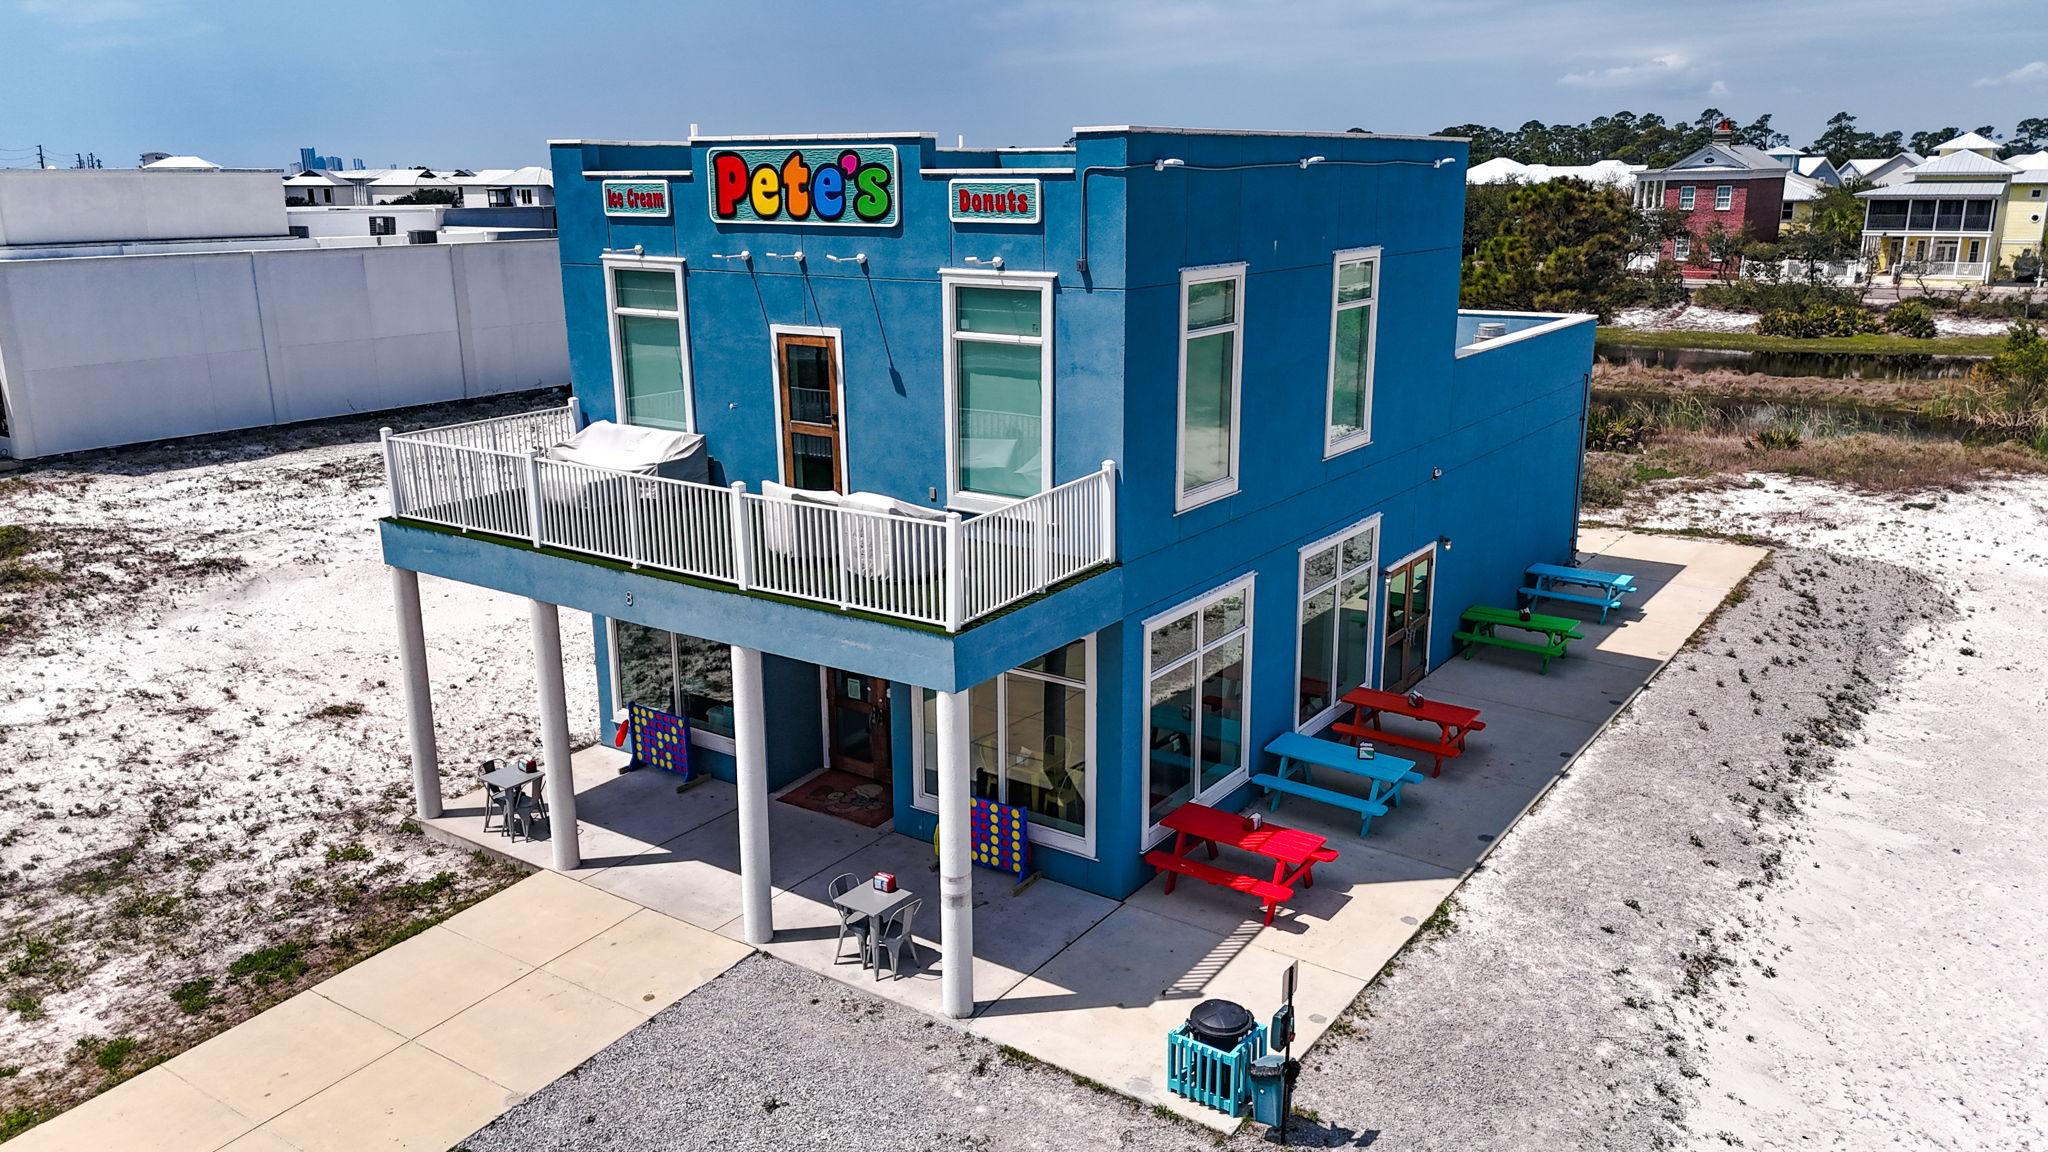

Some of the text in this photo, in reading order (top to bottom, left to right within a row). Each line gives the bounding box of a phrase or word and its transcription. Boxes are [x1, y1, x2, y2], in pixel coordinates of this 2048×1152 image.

[713, 150, 892, 221] Pete's
[607, 188, 664, 208] Ice Cream
[959, 189, 1028, 212] Donuts
[625, 590, 633, 606] 8
